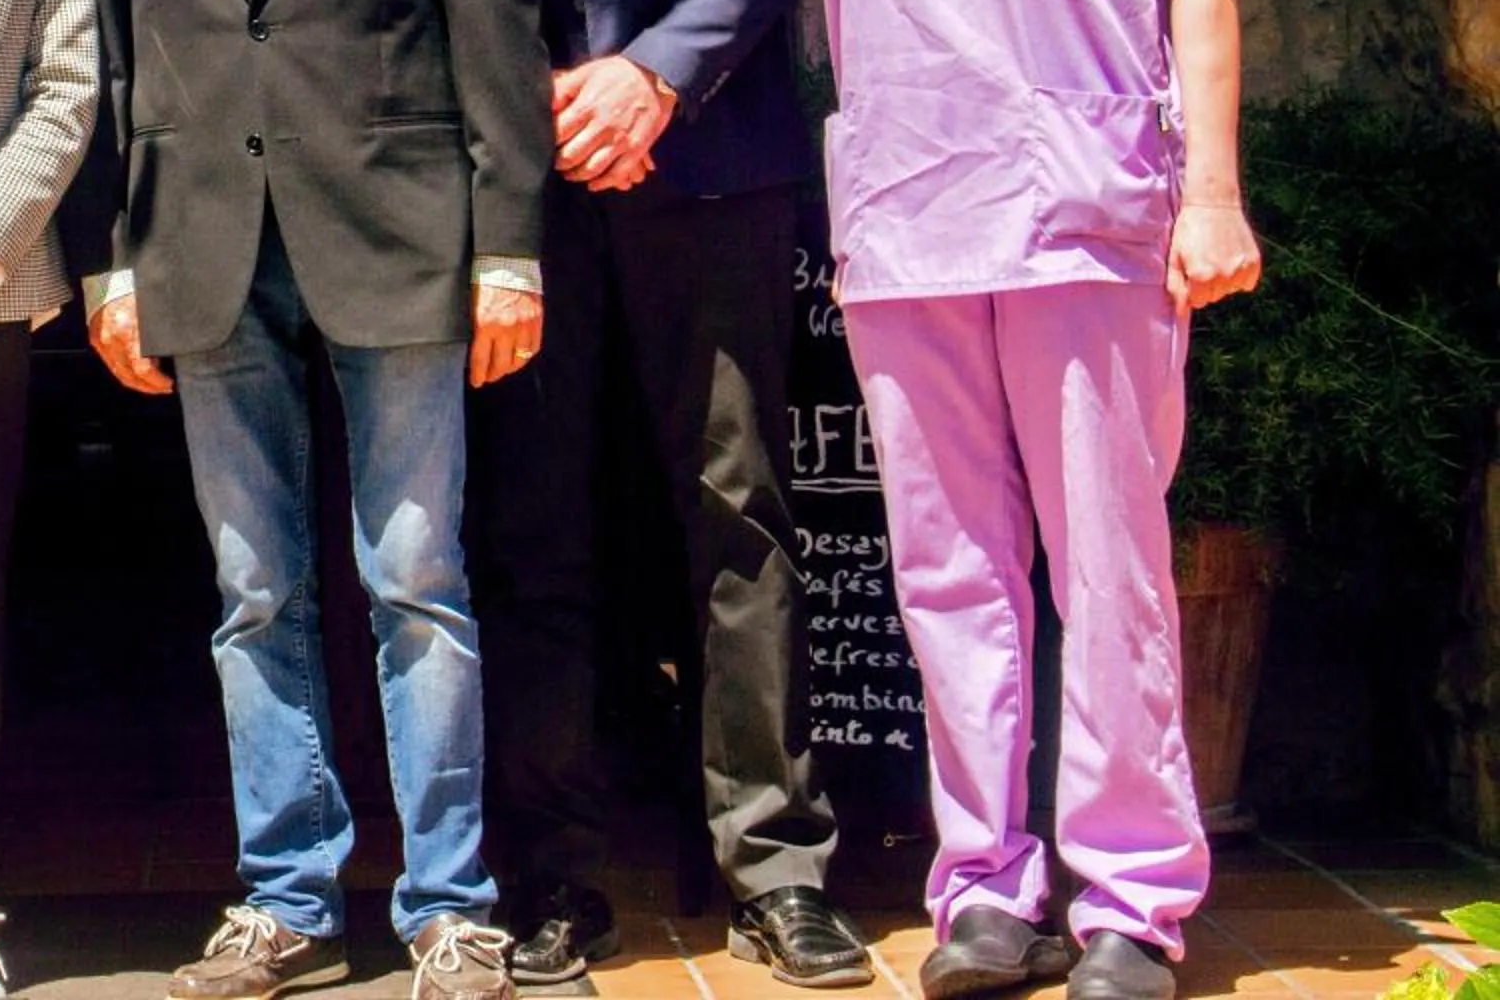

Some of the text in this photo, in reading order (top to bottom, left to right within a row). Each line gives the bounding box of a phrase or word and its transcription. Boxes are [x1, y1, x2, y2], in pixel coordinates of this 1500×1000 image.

[807, 614, 903, 635] ervez
[809, 640, 918, 677] efresc
[809, 683, 927, 713] ombin
[810, 717, 874, 745] into
